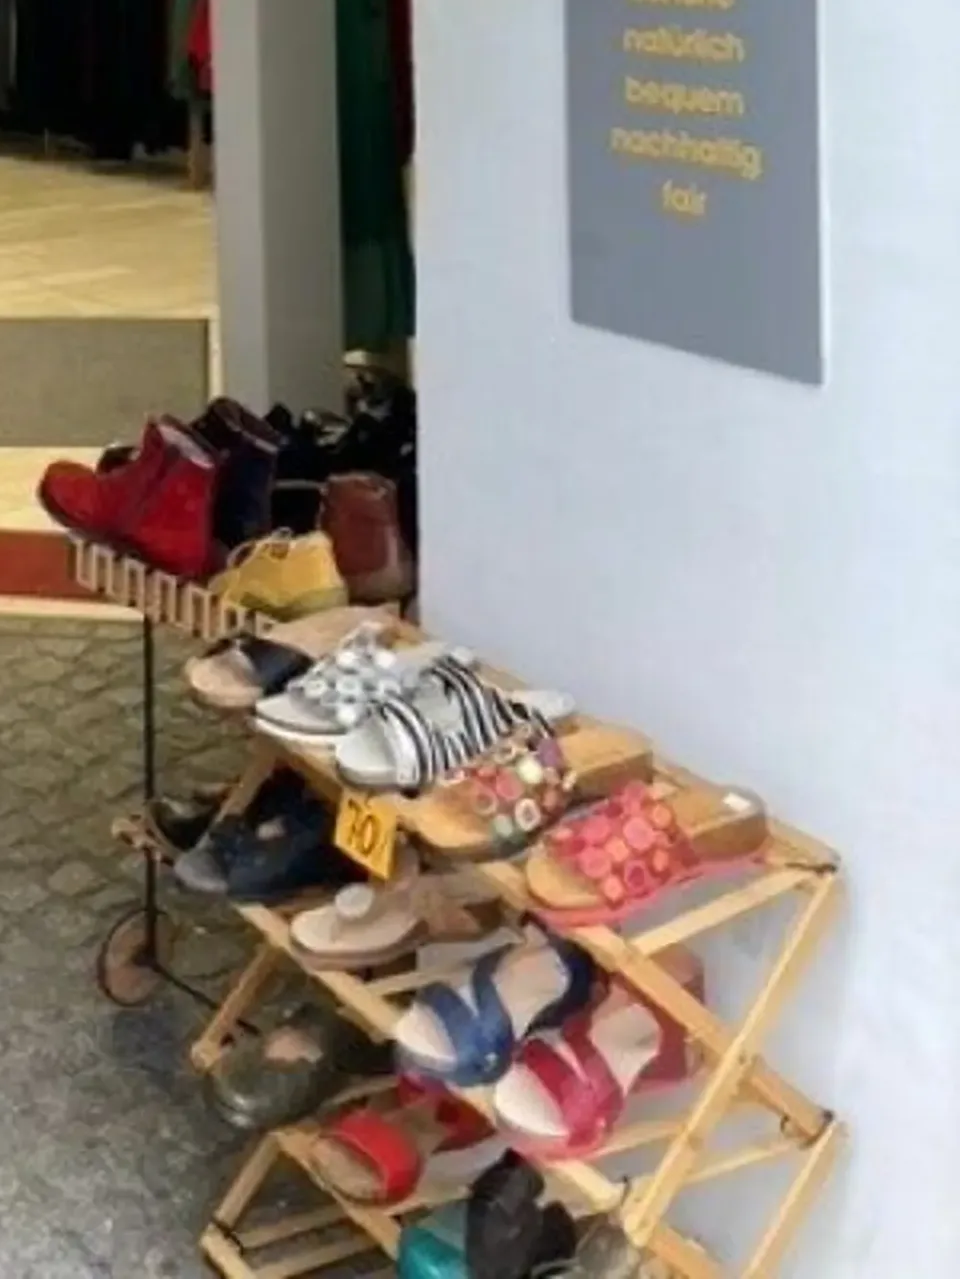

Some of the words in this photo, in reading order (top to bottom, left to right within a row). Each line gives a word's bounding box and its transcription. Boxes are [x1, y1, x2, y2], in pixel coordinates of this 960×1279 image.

[625, 76, 744, 113] bequem
[610, 128, 763, 179] nachhaltig
[663, 181, 705, 216] fair
